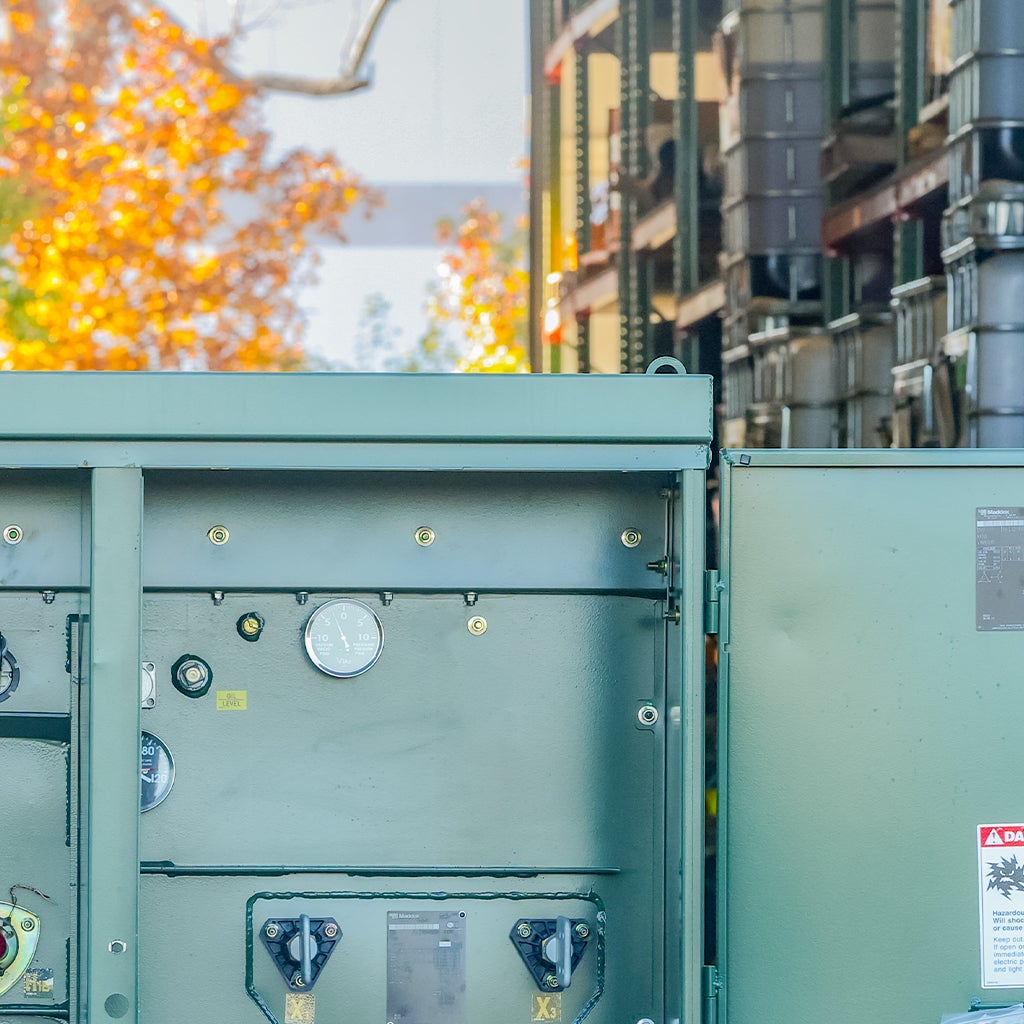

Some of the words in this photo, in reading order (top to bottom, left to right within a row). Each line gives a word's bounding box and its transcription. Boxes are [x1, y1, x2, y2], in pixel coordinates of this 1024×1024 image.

[340, 612, 347, 620] 0
[324, 618, 331, 626] 5
[357, 618, 364, 627] 5
[317, 634, 329, 642] 10
[142, 746, 155, 756] 80
[151, 774, 167, 783] 120
[536, 996, 557, 1020] X3
